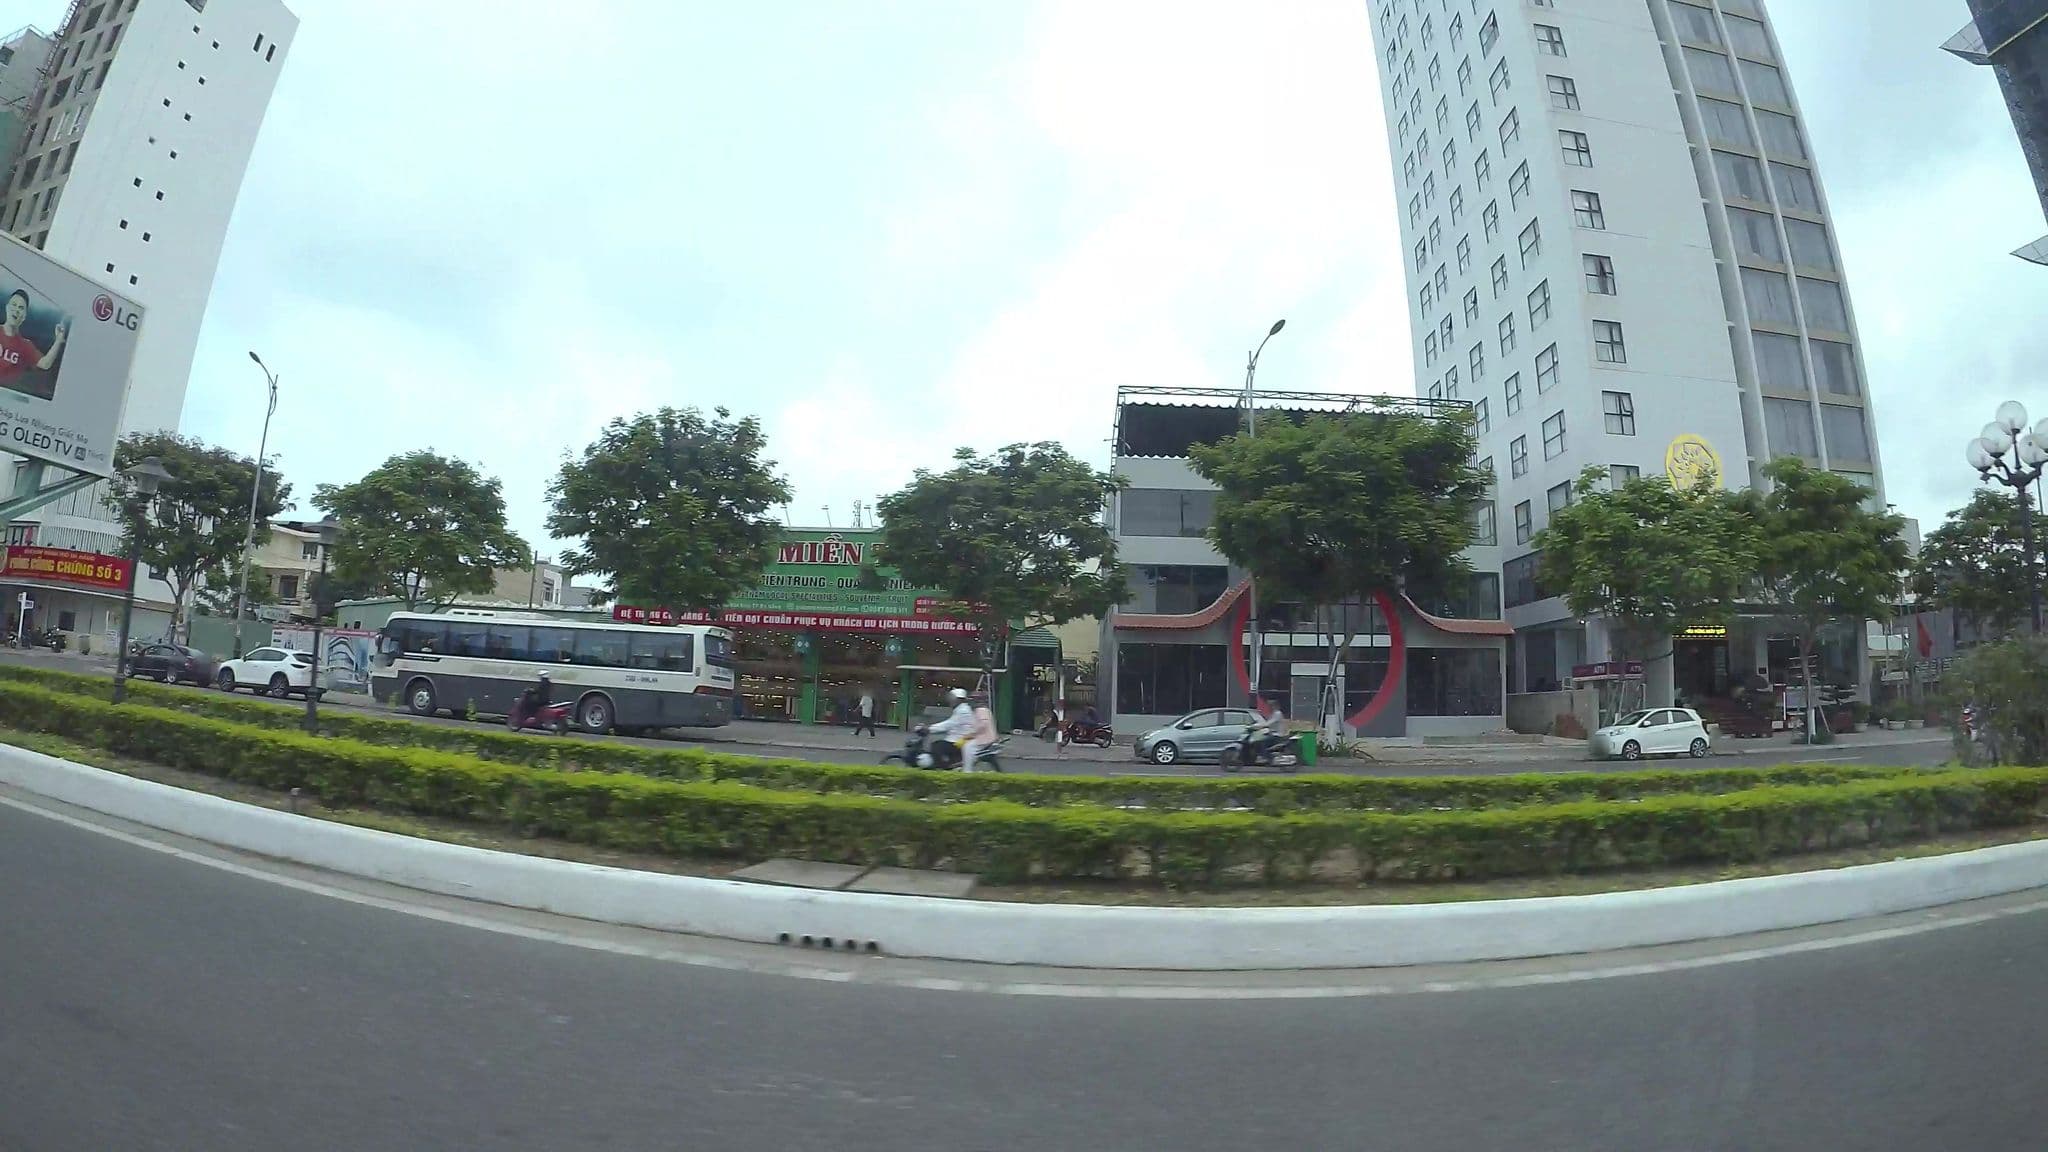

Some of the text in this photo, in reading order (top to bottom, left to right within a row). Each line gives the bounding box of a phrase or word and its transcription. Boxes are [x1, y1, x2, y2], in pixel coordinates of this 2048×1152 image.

[116, 307, 139, 332] LG
[4, 349, 20, 365] LG
[0, 421, 9, 437] G
[14, 427, 52, 450] OLED
[54, 438, 73, 456] TV
[777, 533, 865, 567] MIỀN
[57, 560, 94, 577] CHỨNG
[96, 563, 112, 580] SỐ
[114, 568, 122, 581] 3
[788, 574, 826, 589] TRUNG
